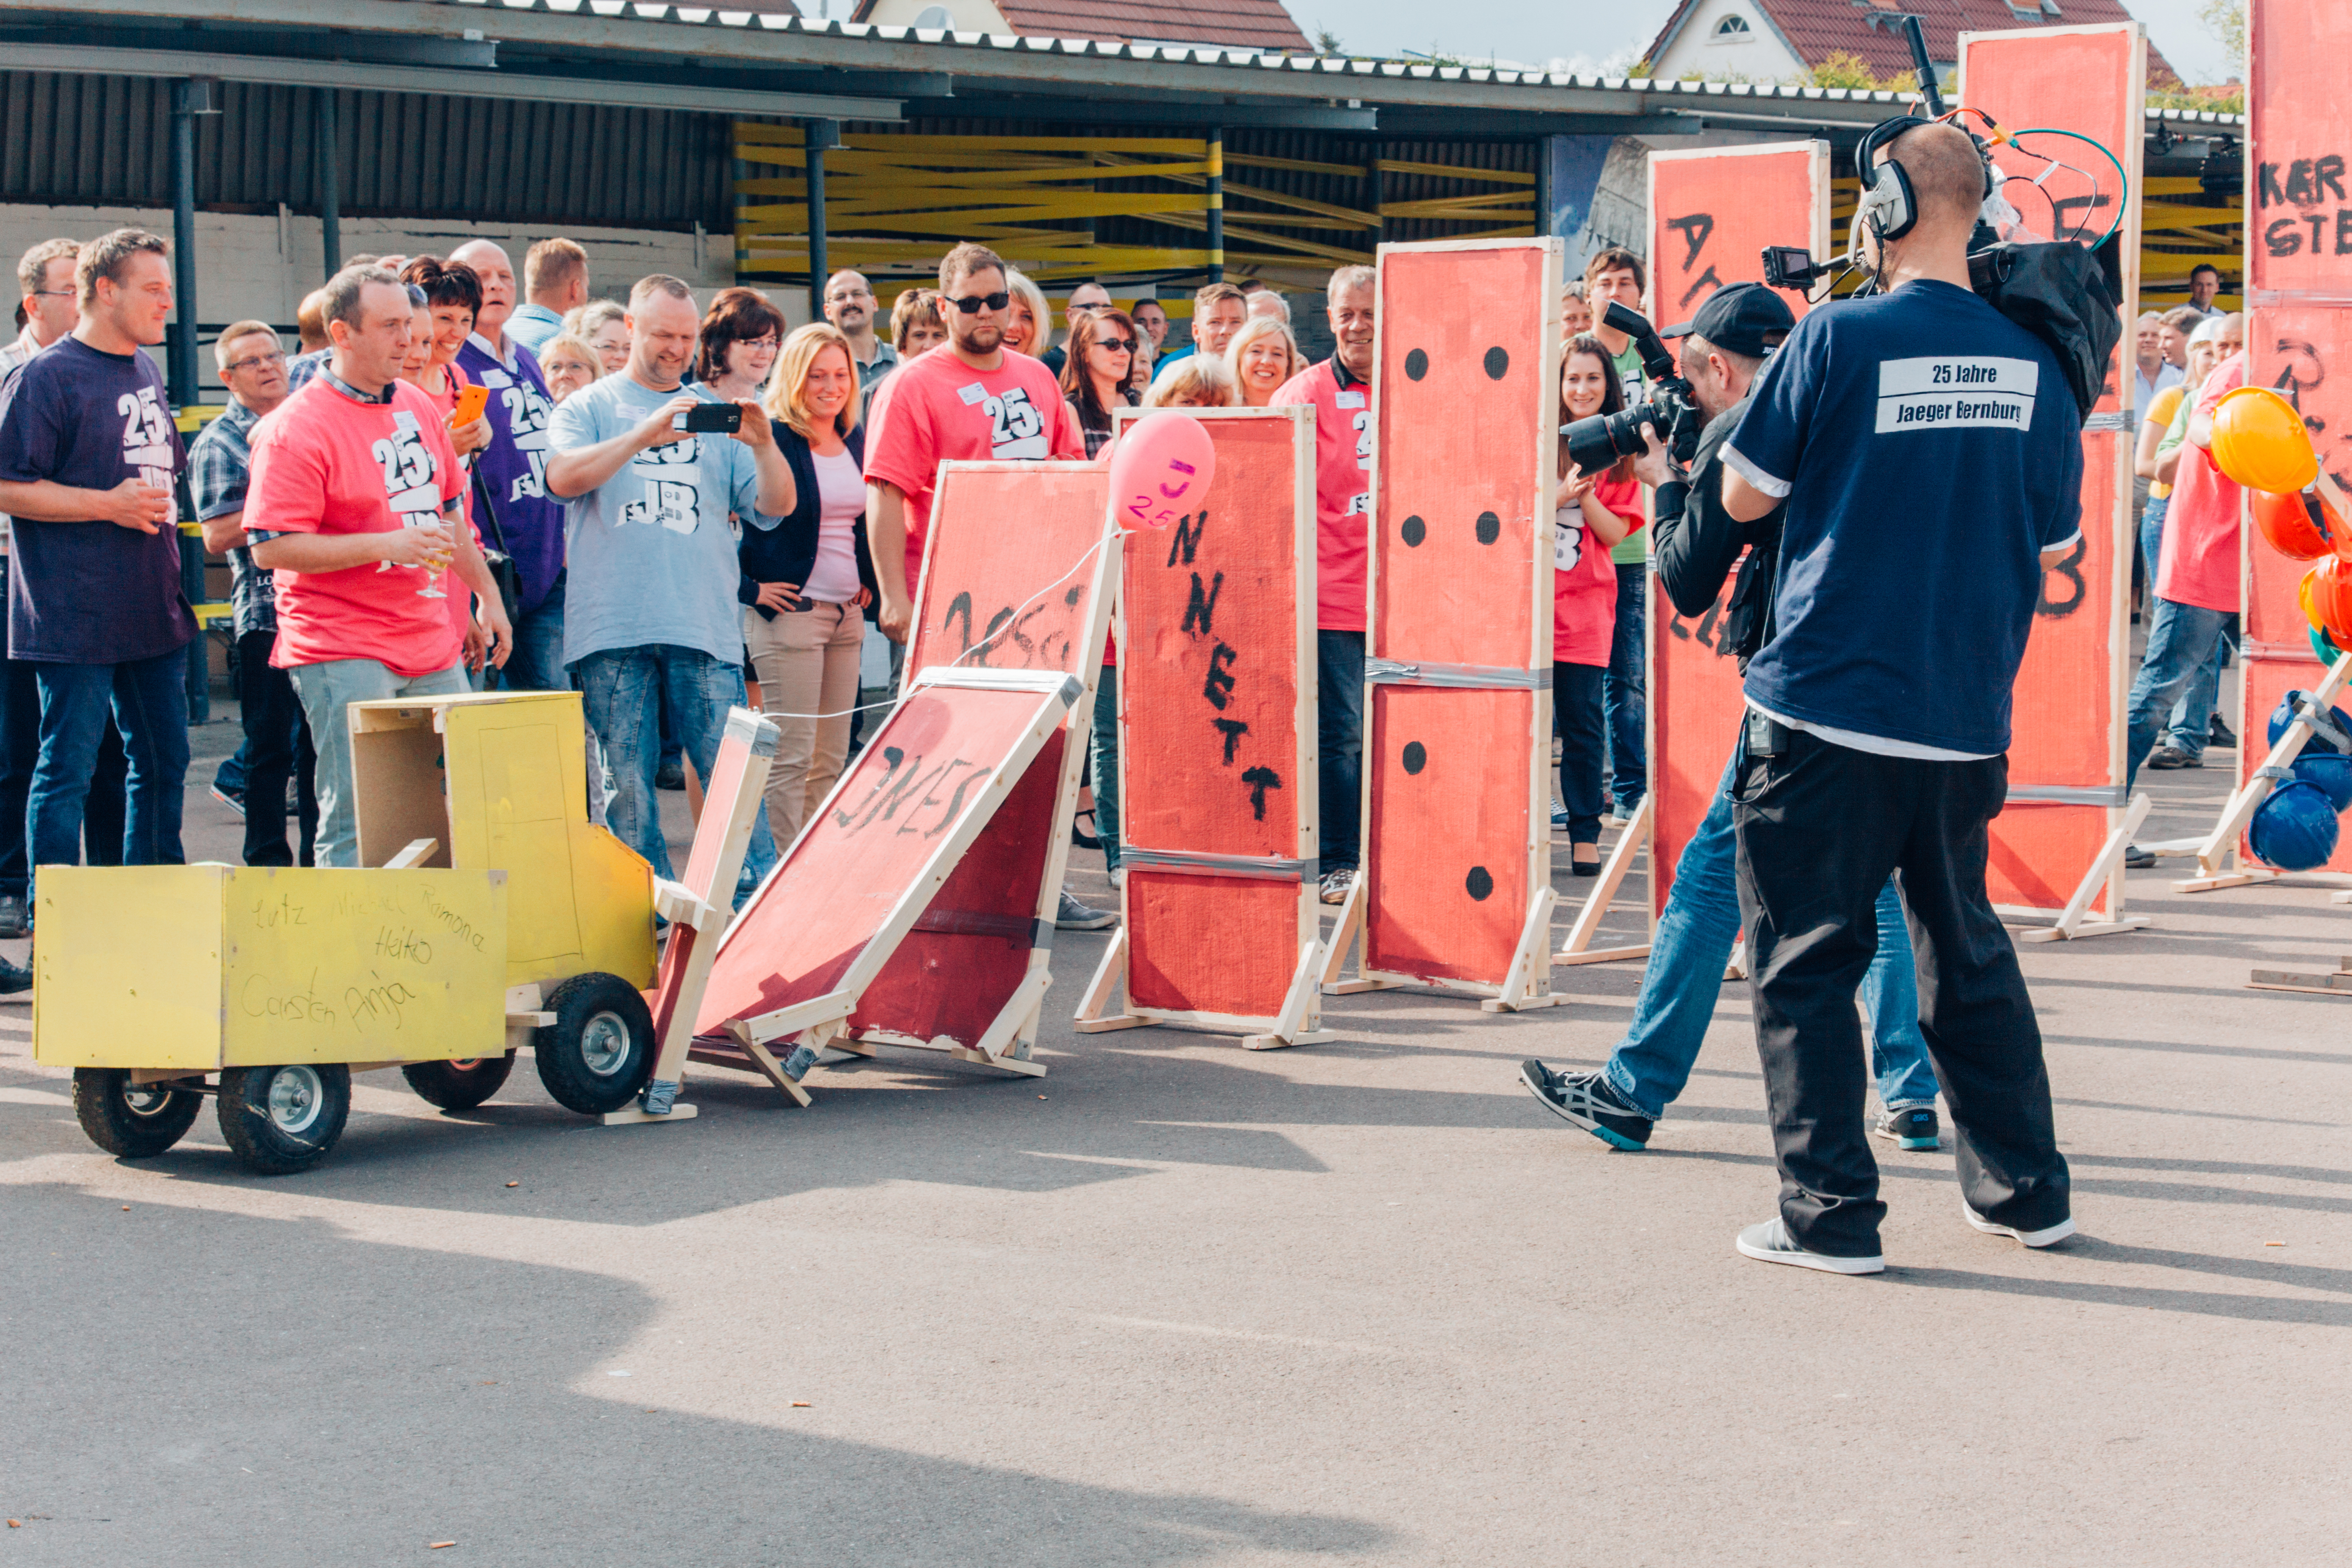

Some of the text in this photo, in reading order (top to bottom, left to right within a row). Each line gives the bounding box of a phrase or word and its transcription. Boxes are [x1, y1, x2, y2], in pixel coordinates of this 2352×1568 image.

[2258, 154, 2348, 209] KER
[1622, 369, 1642, 409] 5
[1933, 364, 1997, 384] 25 Jahre
[118, 385, 166, 447] 25
[501, 380, 552, 435] 25
[982, 387, 1041, 443] 25
[1353, 410, 1372, 455] 2
[1896, 400, 2021, 423] Jaeger Bernburg
[372, 429, 434, 494] 25
[1127, 495, 1176, 527] 25
[1555, 523, 1582, 571] B
[256, 575, 274, 587] LO
[1168, 511, 1282, 821] NNETT
[251, 893, 307, 929] Lutz
[420, 883, 485, 953] Ramona
[375, 925, 432, 965] Heiko
[344, 970, 416, 1033] Anja
